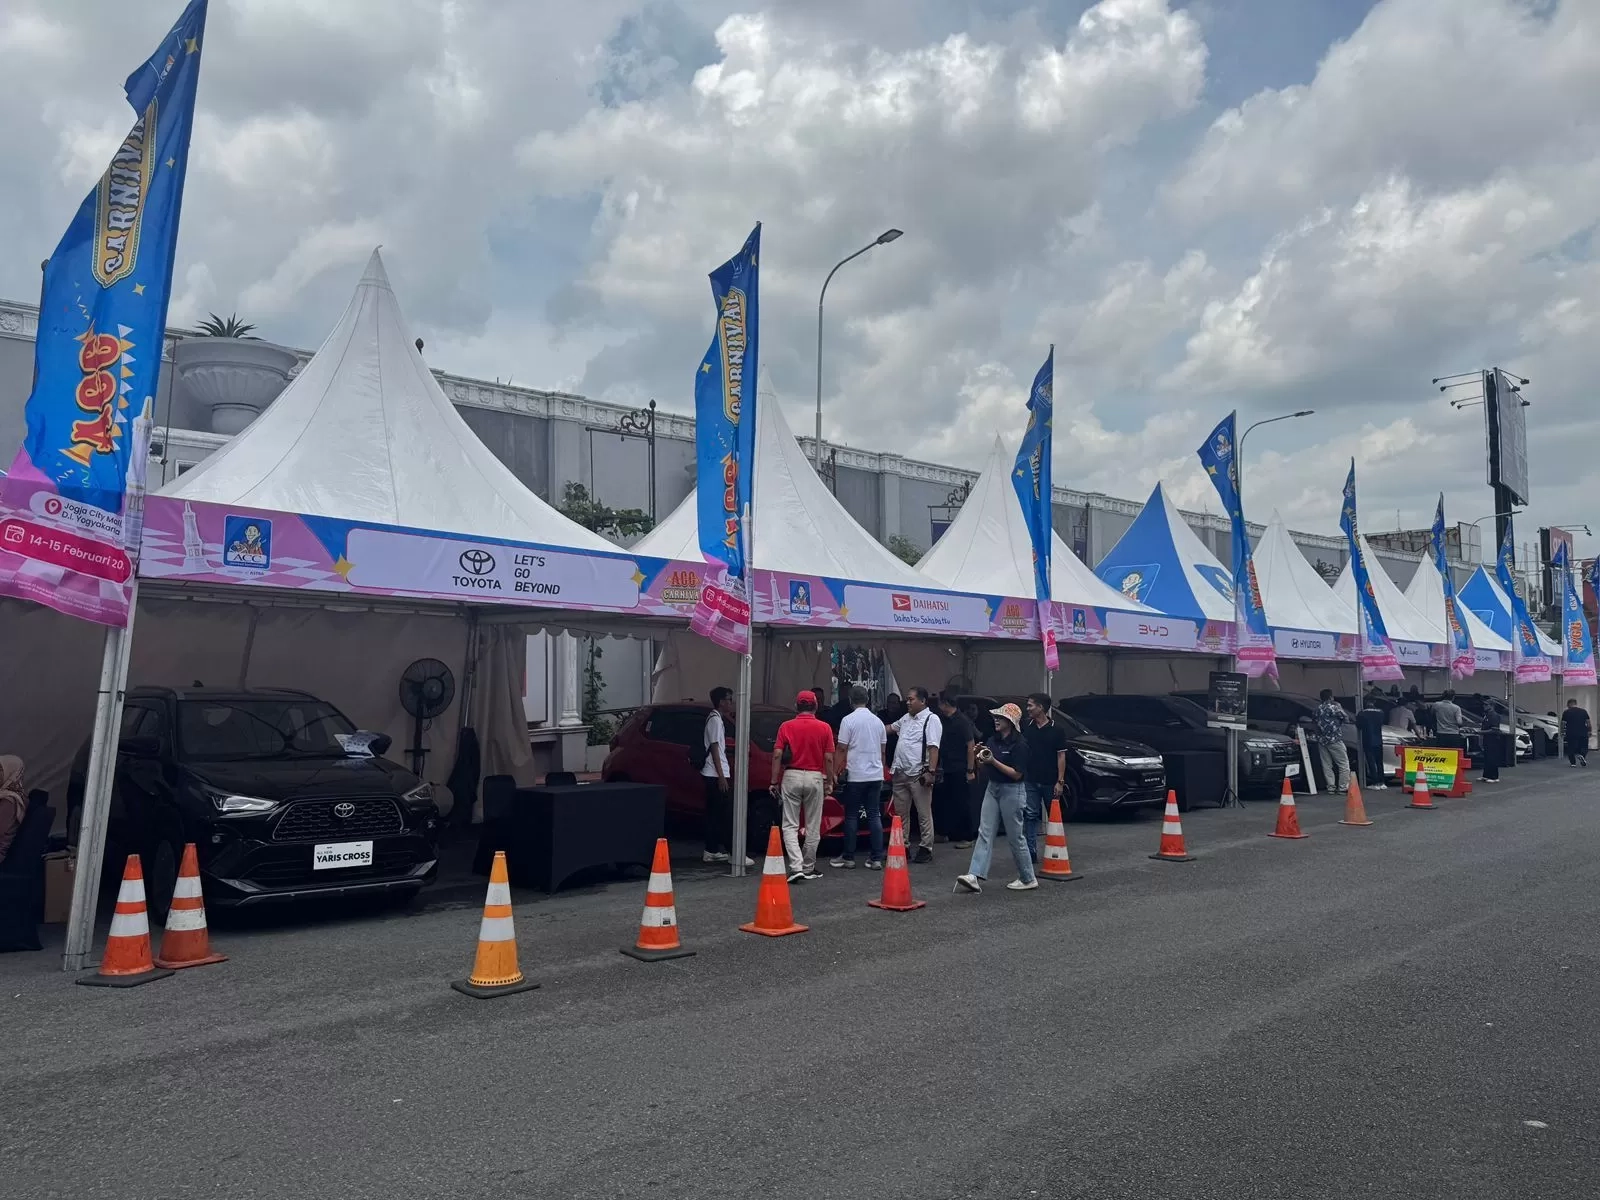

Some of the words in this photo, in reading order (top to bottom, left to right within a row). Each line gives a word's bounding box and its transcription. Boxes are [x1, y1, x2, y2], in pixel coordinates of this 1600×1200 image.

[71, 333, 121, 454] ACC
[64, 503, 87, 515] Jogja
[89, 509, 105, 521] City
[29, 535, 61, 551] 14-15
[63, 544, 111, 566] Februari
[233, 553, 262, 562] ACC
[514, 554, 546, 567] LET'S
[514, 568, 531, 579] GO
[452, 575, 502, 590] TOYOTA
[514, 581, 561, 595] BEYOND
[913, 599, 950, 611] DAIHATSU
[1138, 624, 1169, 637] BYD
[844, 678, 879, 692] rangler
[1413, 755, 1447, 764] POWER
[316, 854, 342, 863] YARIS
[342, 852, 371, 861] CROSS
